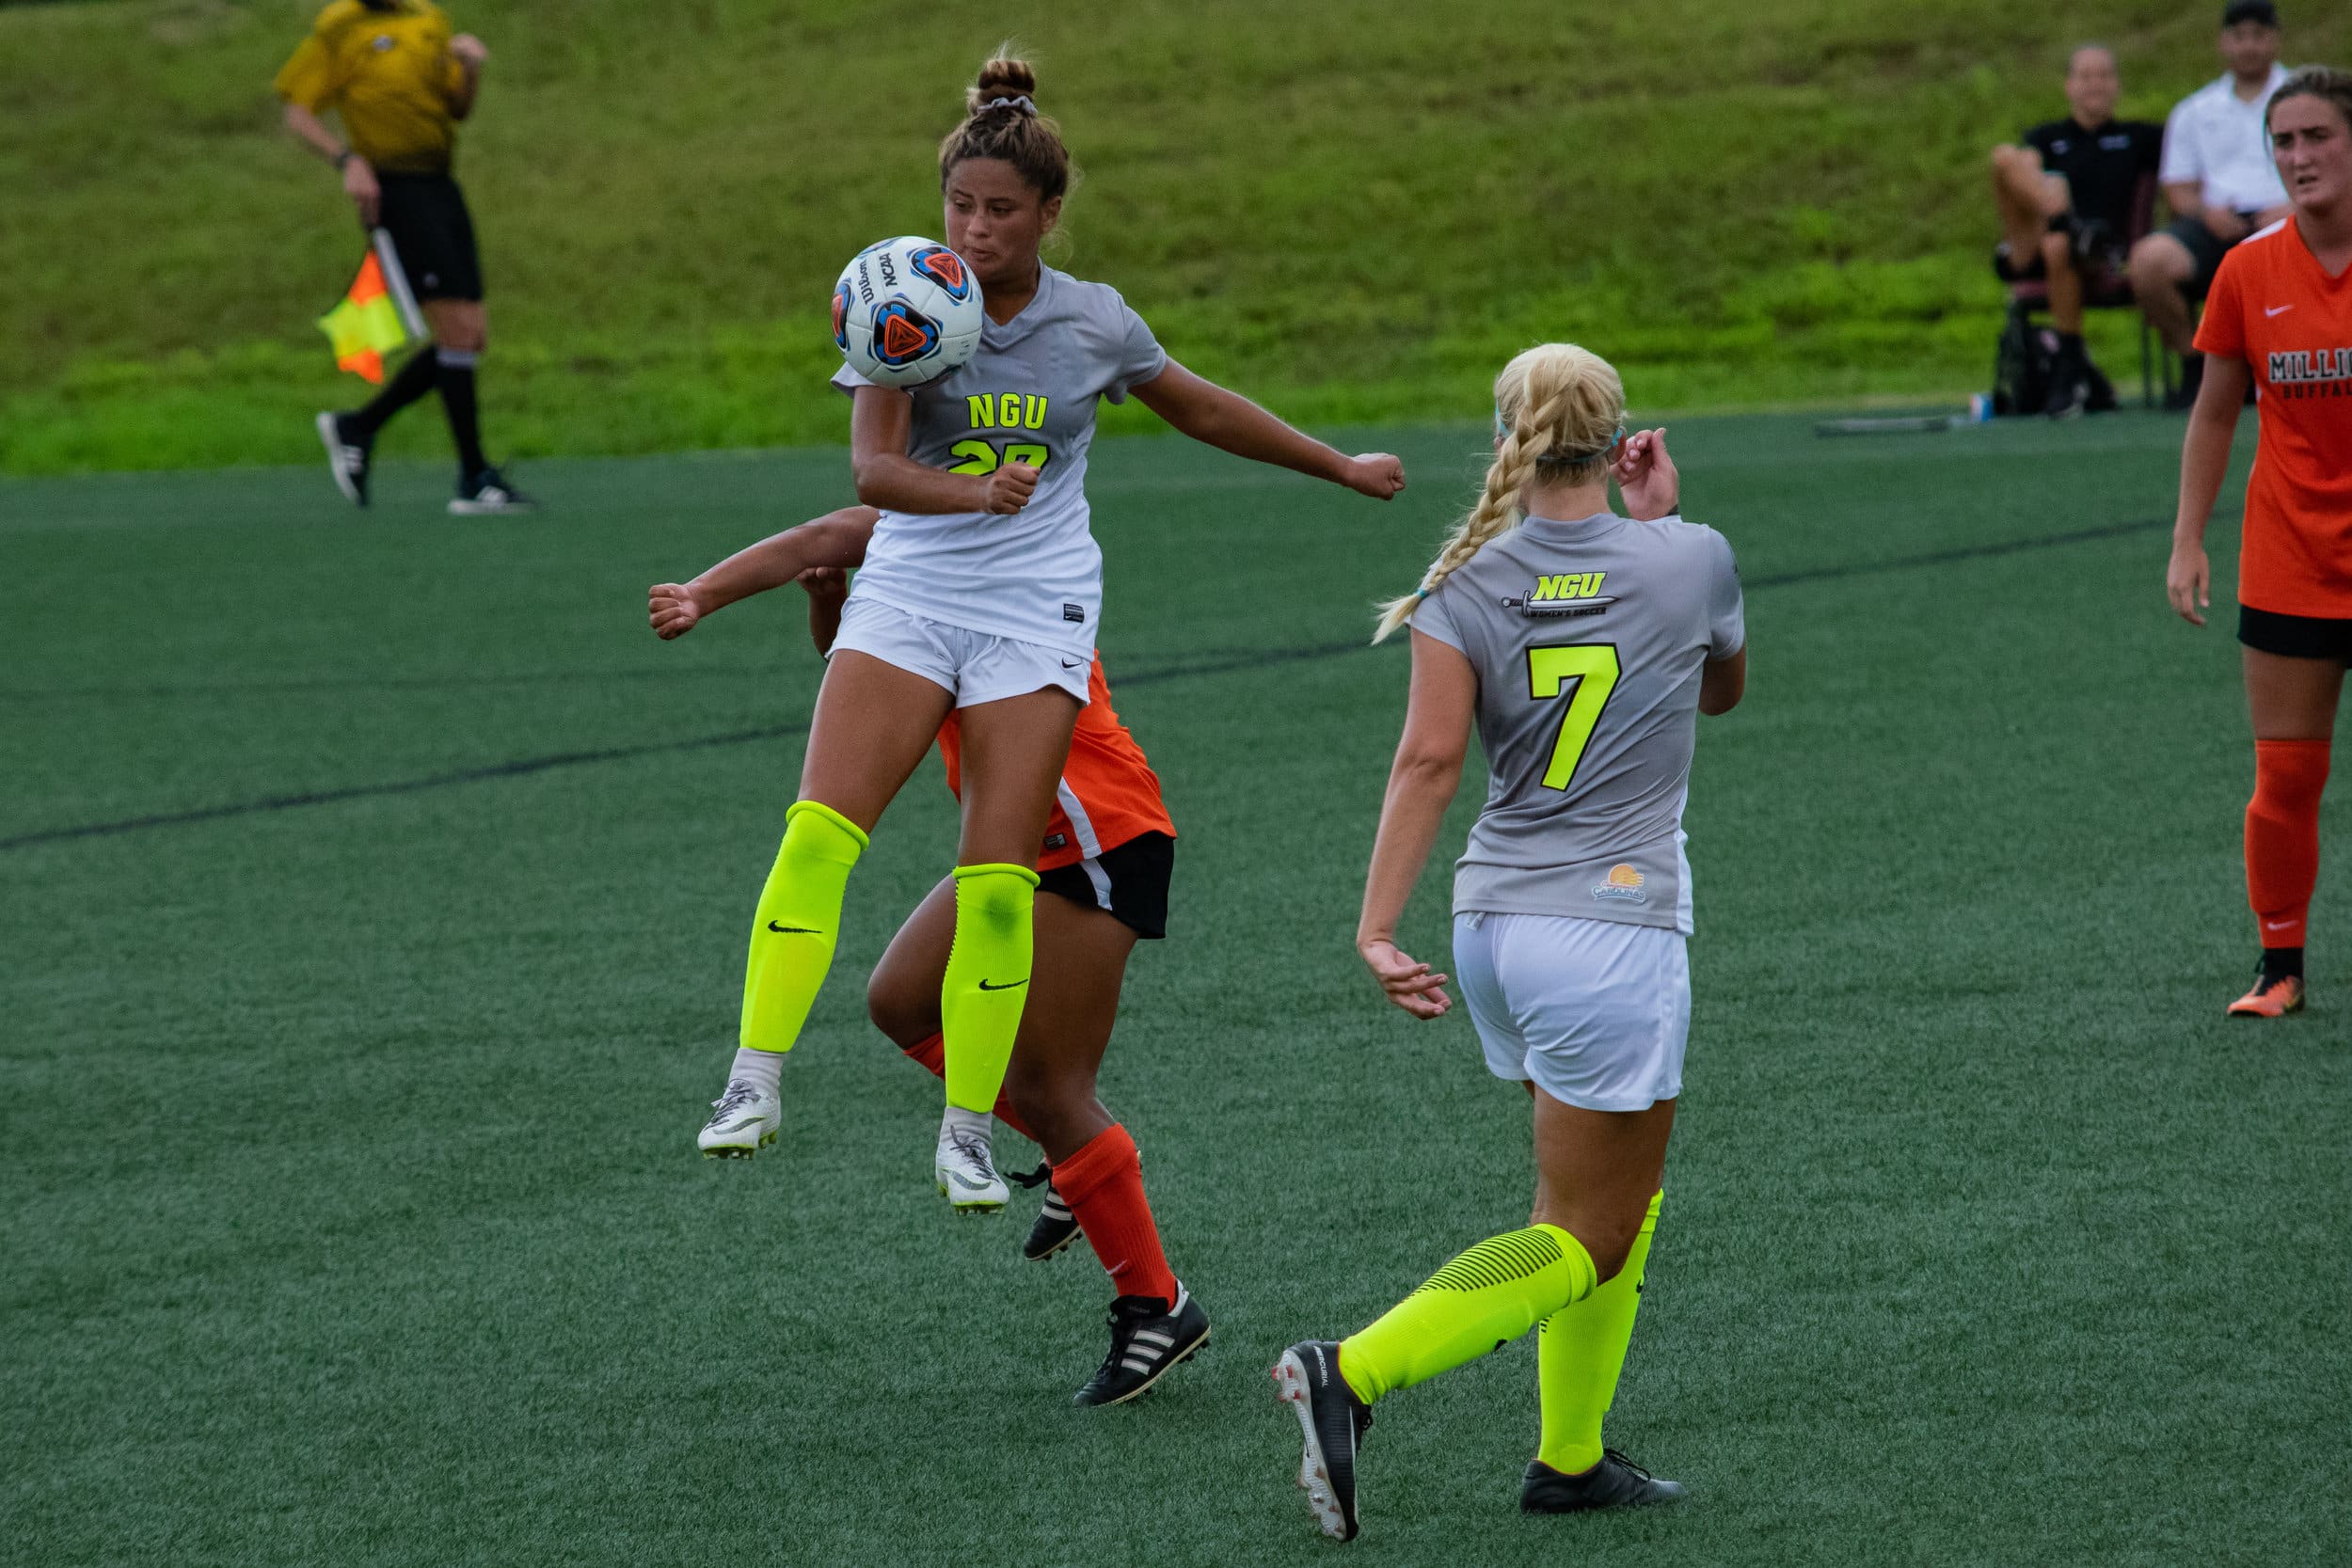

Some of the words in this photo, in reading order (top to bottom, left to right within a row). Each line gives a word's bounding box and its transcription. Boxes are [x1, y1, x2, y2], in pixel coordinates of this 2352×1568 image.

[879, 252, 898, 288] NCAA
[965, 392, 1049, 429] NGU
[1531, 571, 1608, 600] NGU
[1531, 609, 1571, 617] WOMEN'S
[1572, 607, 1607, 616] SOCCER
[1525, 641, 1622, 792] 7
